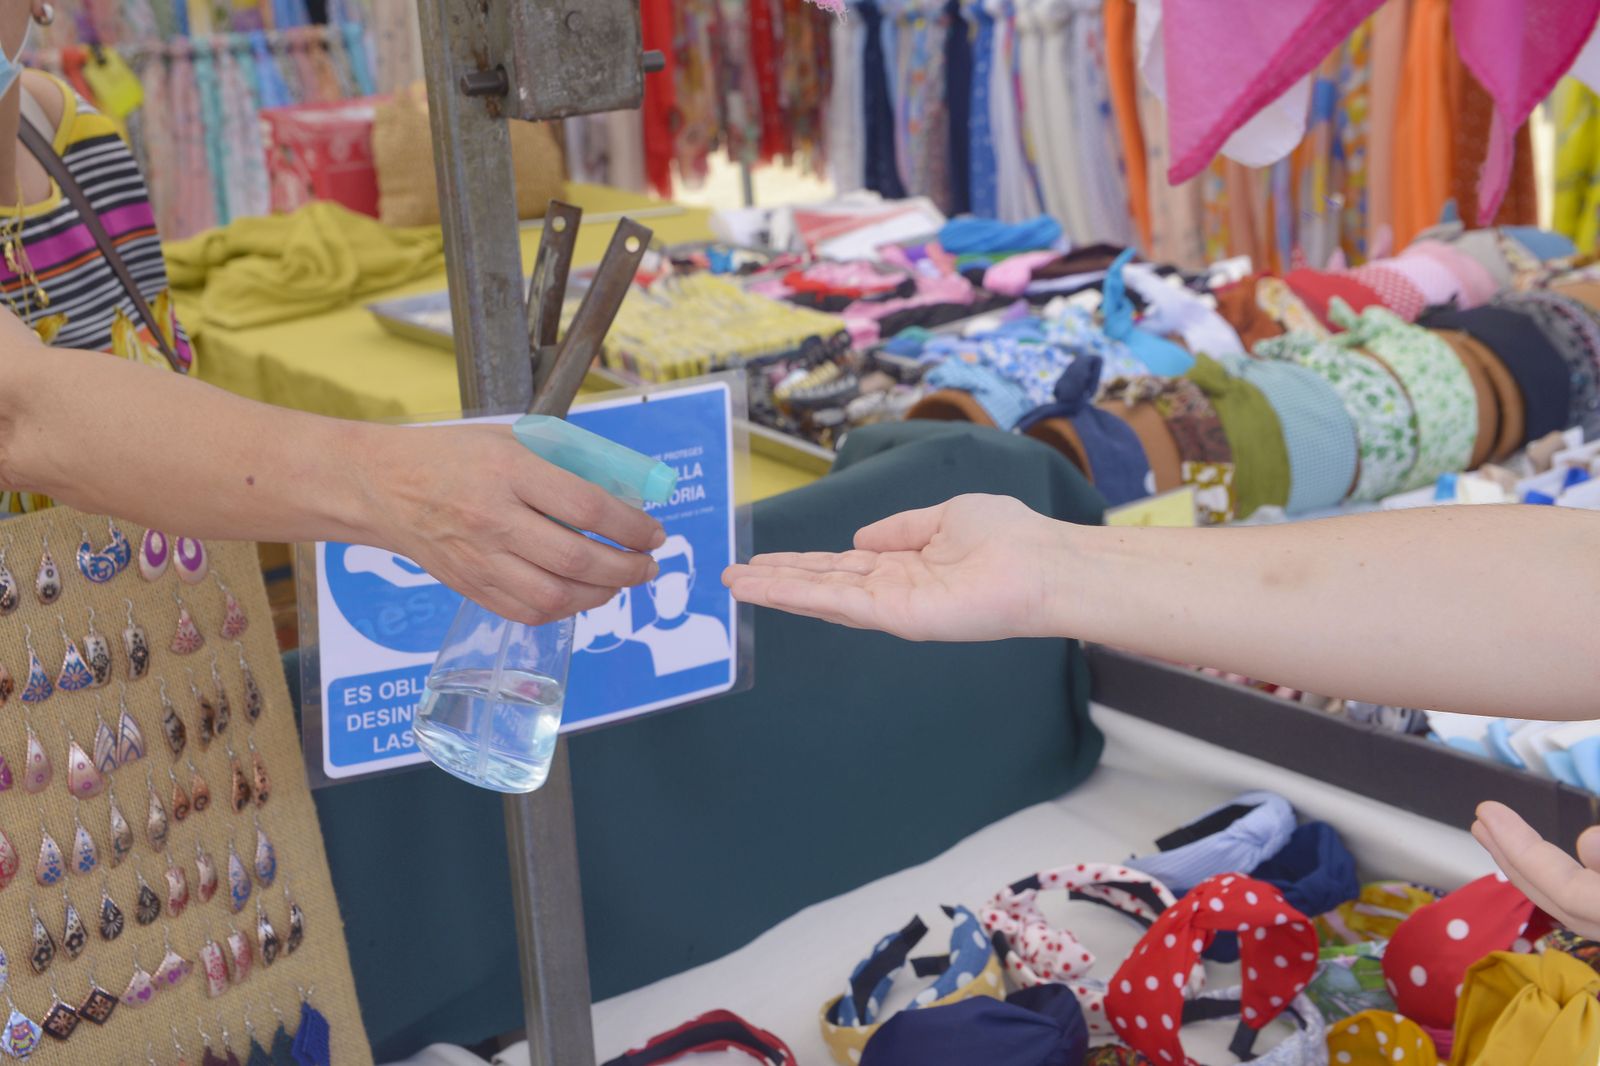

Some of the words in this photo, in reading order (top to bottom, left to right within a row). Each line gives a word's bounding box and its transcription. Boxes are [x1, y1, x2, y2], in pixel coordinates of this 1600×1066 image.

[674, 462, 704, 481] LLA
[343, 685, 372, 706] ES
[379, 676, 429, 700] OBLI
[346, 703, 418, 732] DESIN
[373, 730, 415, 754] LAS
